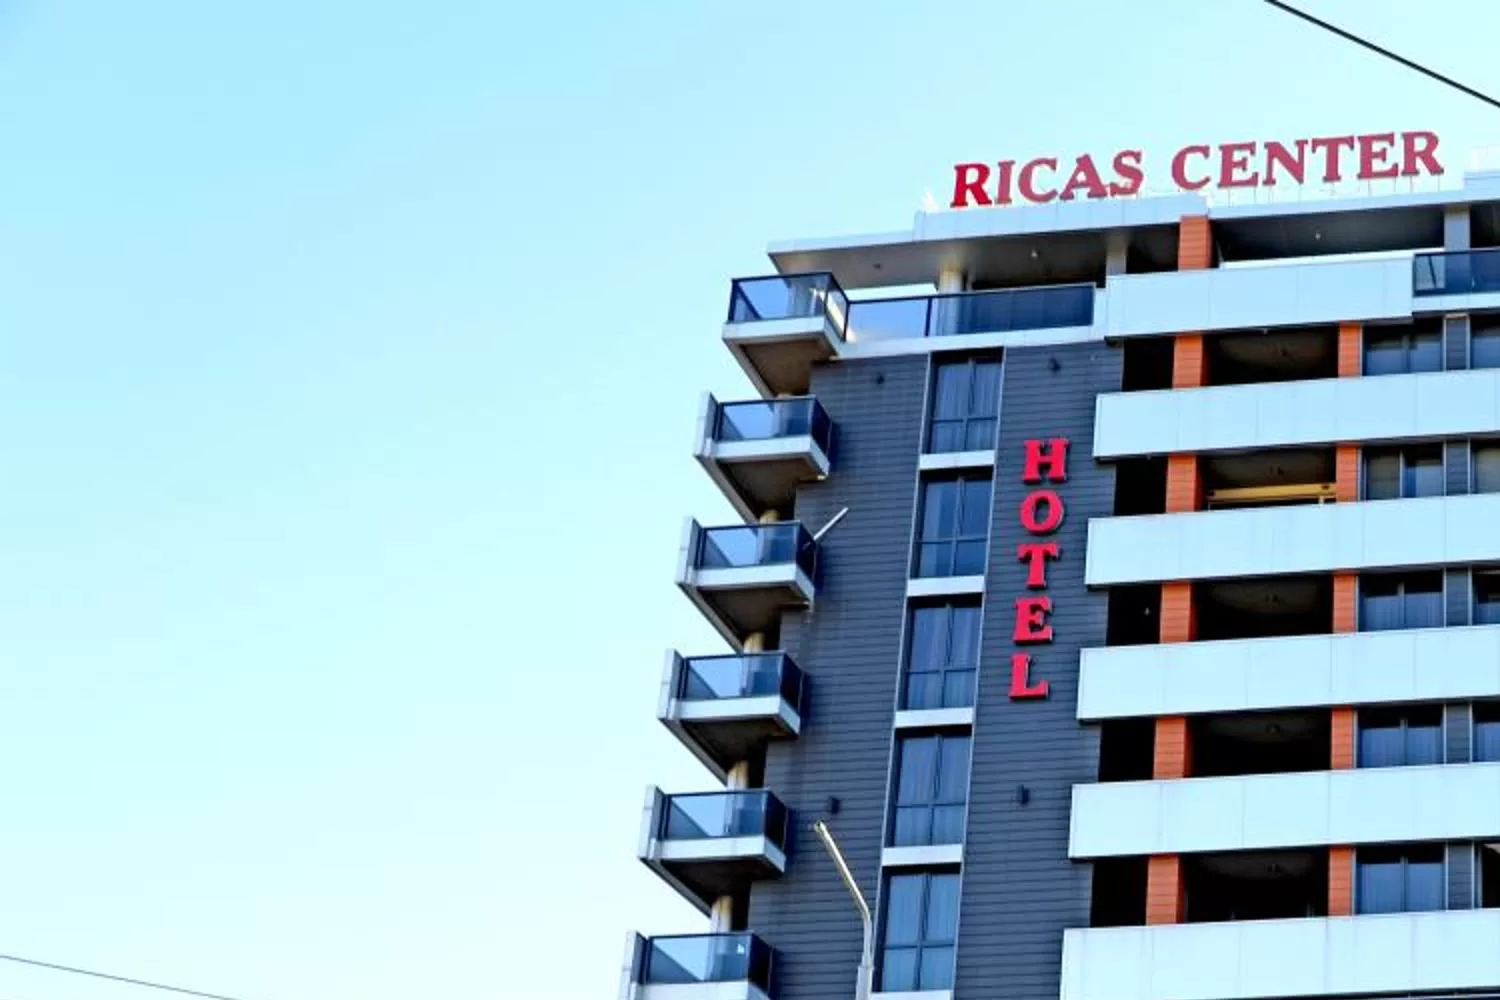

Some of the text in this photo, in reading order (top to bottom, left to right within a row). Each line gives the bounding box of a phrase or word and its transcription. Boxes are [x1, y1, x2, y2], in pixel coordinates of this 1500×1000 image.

[950, 131, 1444, 207] RICAS CENTER
[1008, 438, 1069, 699] HOTEL
